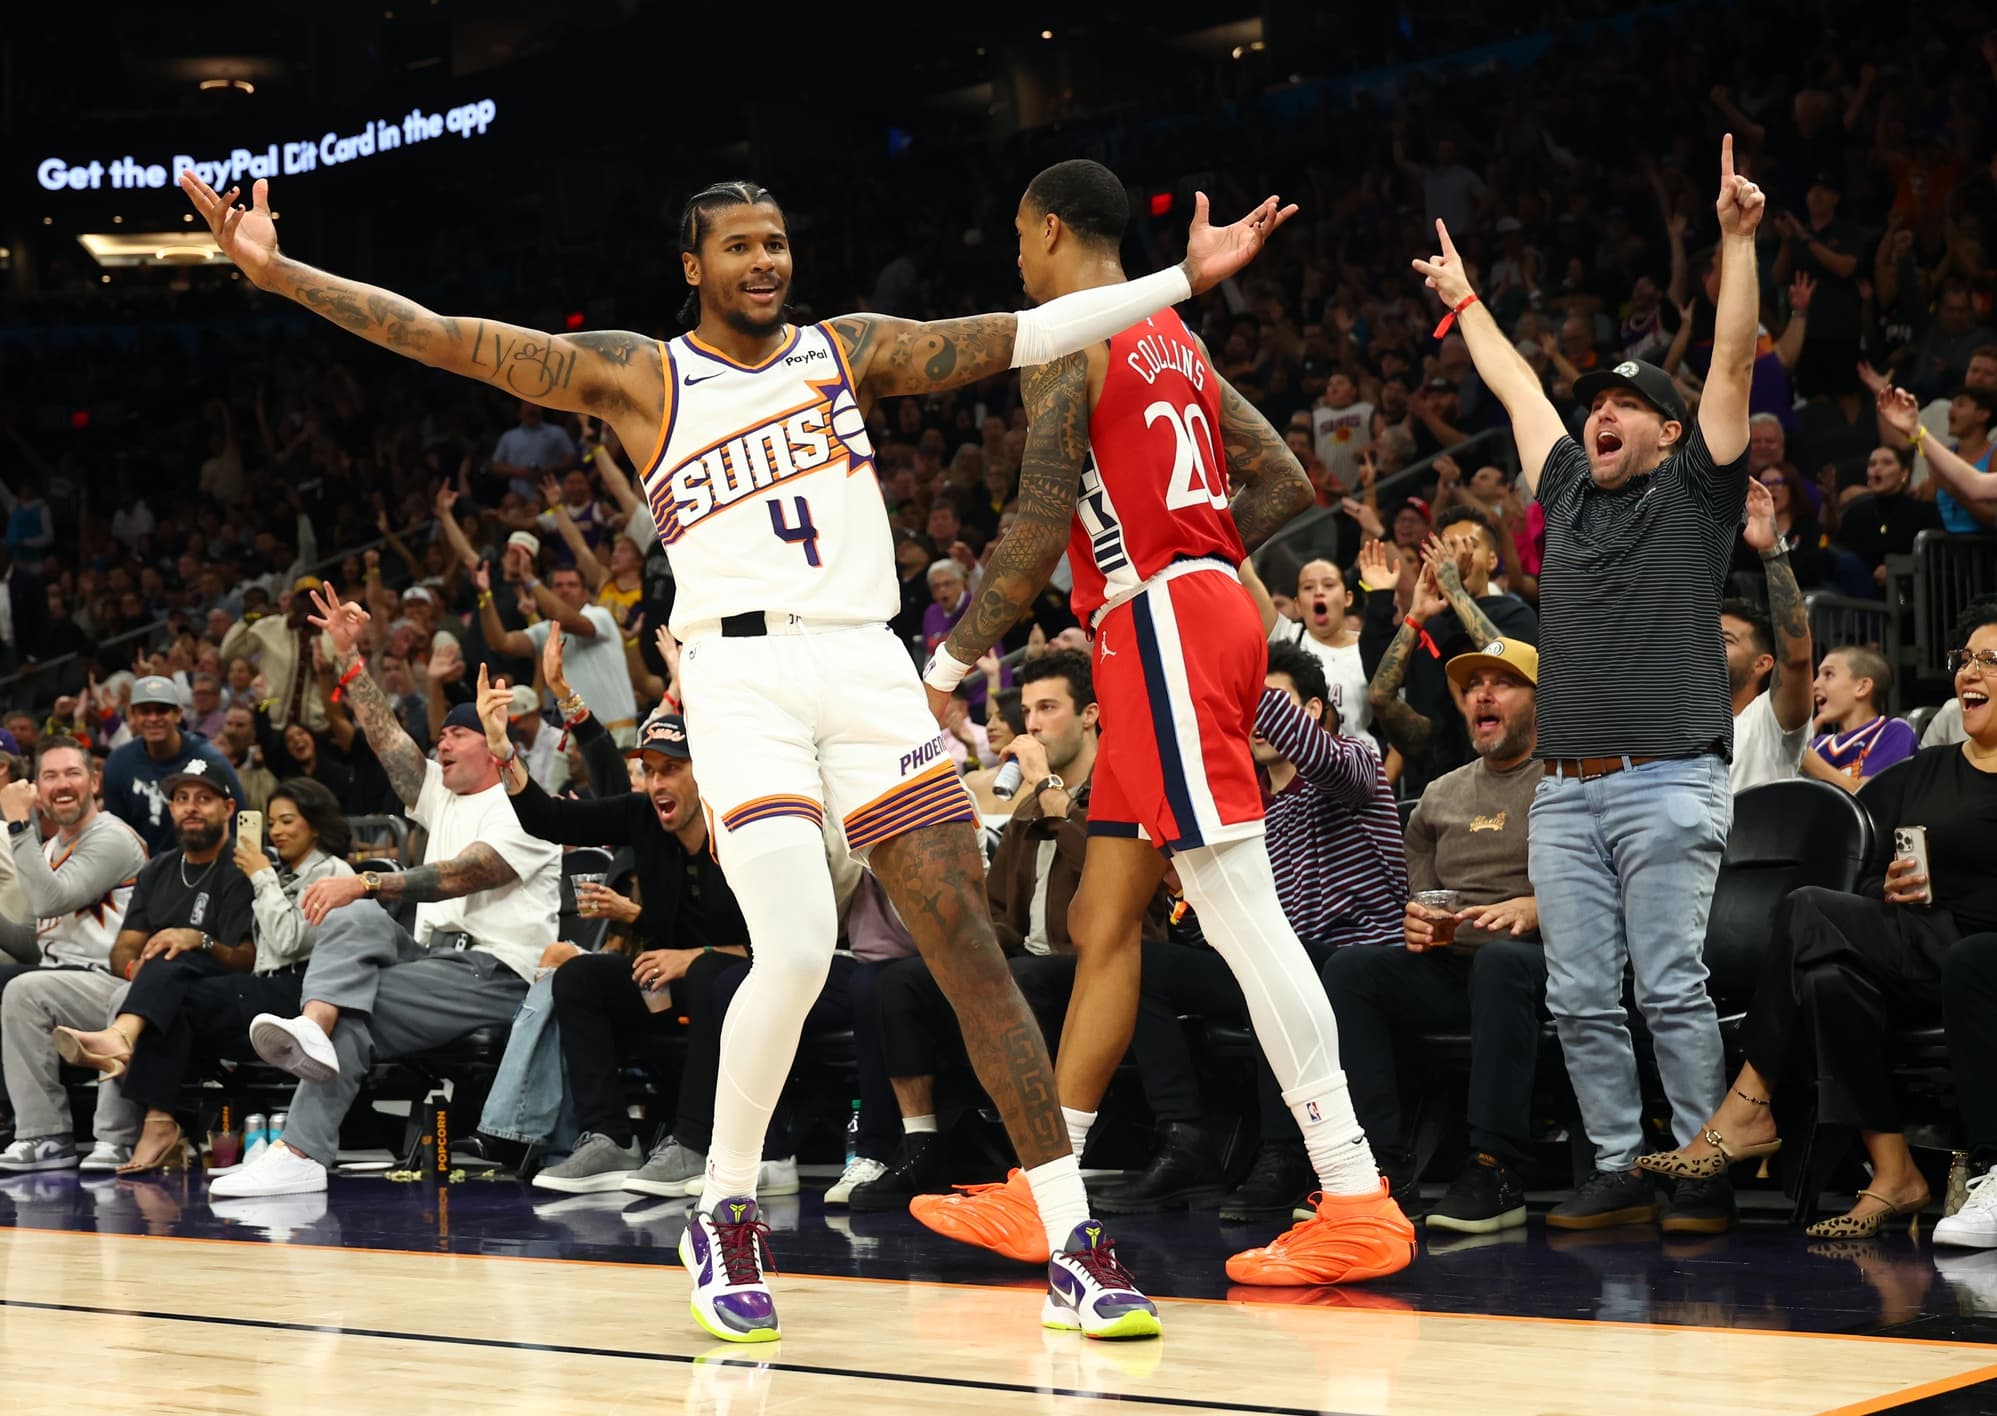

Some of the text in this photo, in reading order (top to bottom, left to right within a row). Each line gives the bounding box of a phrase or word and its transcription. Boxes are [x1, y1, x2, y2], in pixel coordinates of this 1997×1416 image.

[37, 157, 104, 190] Get
[108, 156, 167, 188] the
[172, 144, 279, 192] PayPal
[320, 121, 375, 166] Card
[377, 119, 401, 151] in
[403, 108, 444, 144] the
[446, 98, 496, 138] app
[785, 348, 828, 366] PayPal
[1127, 334, 1205, 392] COLLINS
[670, 407, 830, 527] SUNS
[1143, 400, 1229, 511] 20
[766, 495, 823, 568] 4
[436, 1110, 448, 1171] POPCORN
